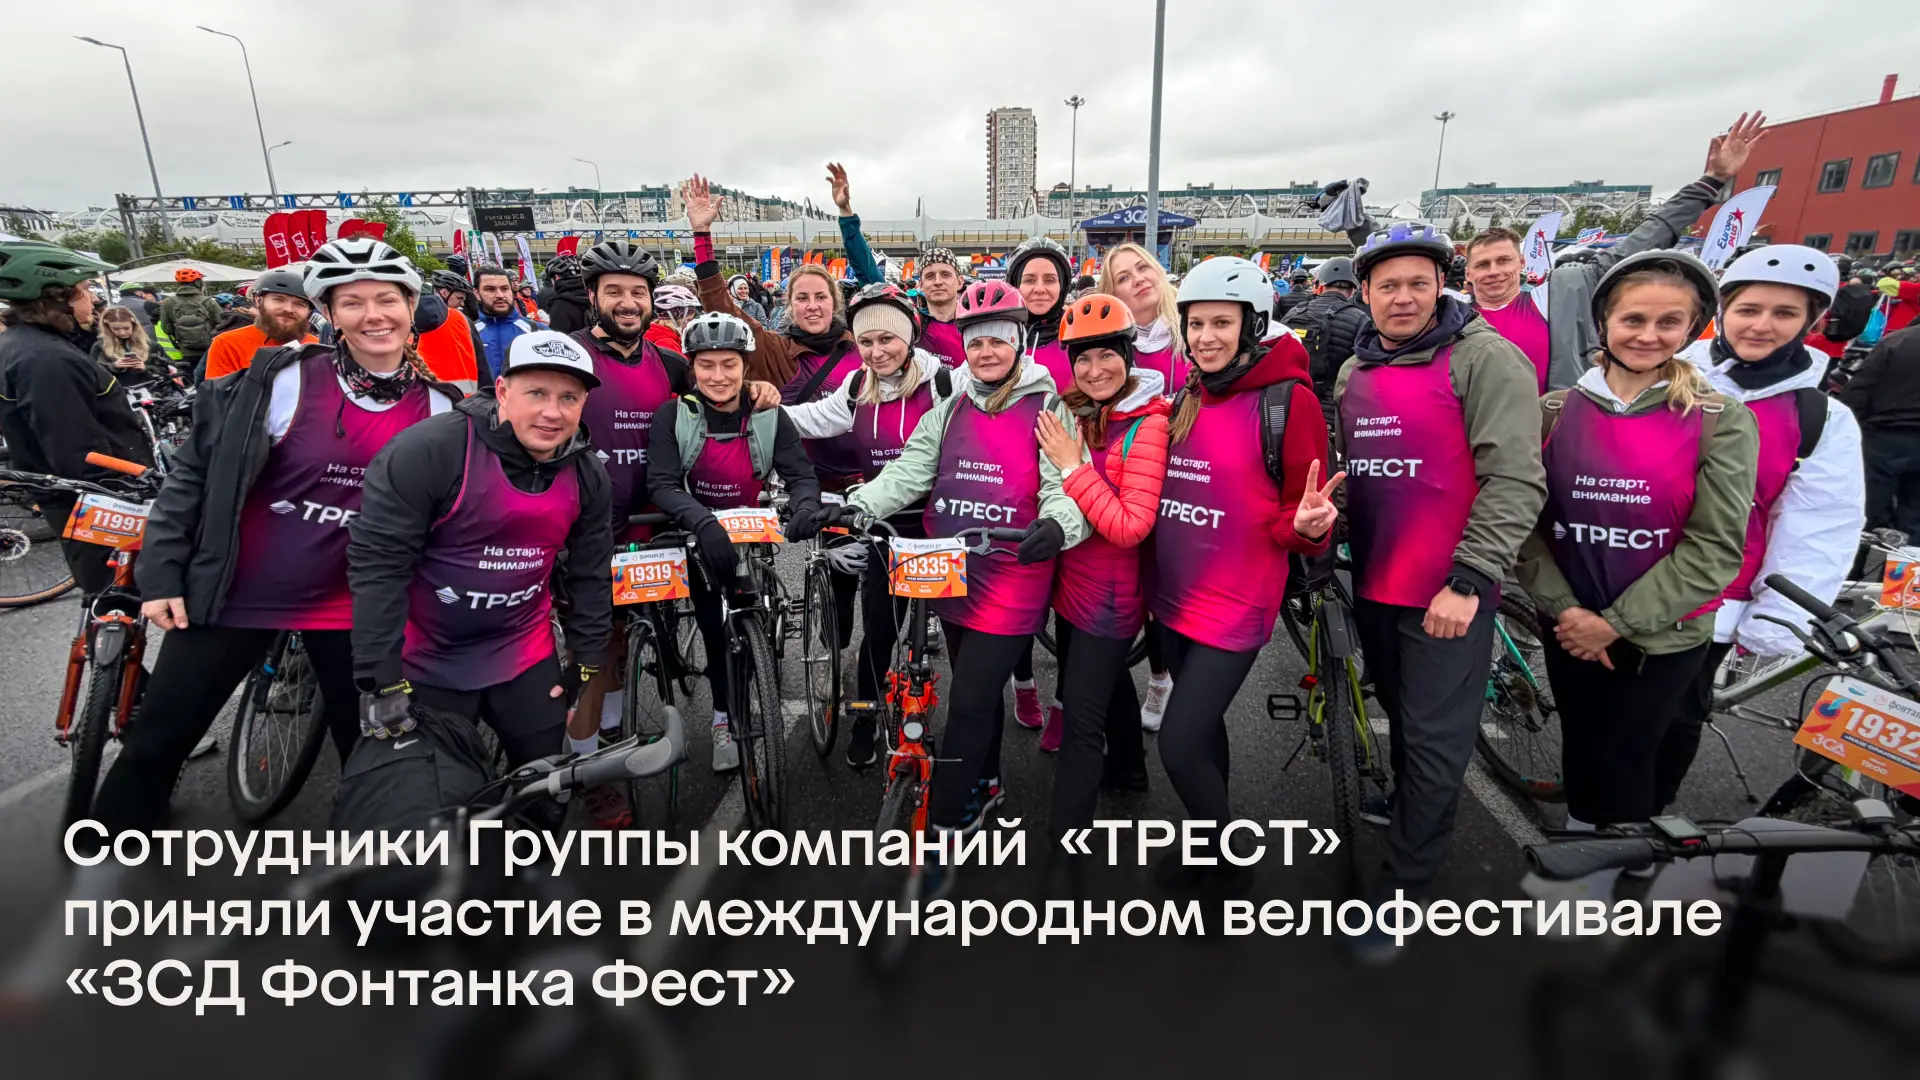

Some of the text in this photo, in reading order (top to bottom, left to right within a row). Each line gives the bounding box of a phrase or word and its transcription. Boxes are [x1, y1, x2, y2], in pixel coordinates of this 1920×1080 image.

[614, 409, 628, 419] На
[1356, 415, 1401, 427] На старт,
[1353, 427, 1403, 438] внимание
[612, 448, 648, 465] ТРЕ
[870, 448, 884, 457] На
[326, 462, 348, 474] На
[958, 459, 1004, 474] На старт,
[1170, 454, 1211, 471] На старт,
[1350, 458, 1423, 478] ТРЕСТ
[955, 472, 1004, 485] внимание
[1167, 469, 1211, 484] внимание
[1575, 474, 1650, 491] На старт,
[697, 480, 710, 489] На
[1572, 490, 1652, 505] внимание
[302, 500, 361, 528] ТРЕ
[948, 498, 1017, 524] ТРЕСТ
[1160, 498, 1225, 529] ТРЕСТ
[93, 509, 145, 533] 11991
[723, 517, 765, 529] 19315
[1568, 522, 1671, 550] ТРЕСТ
[483, 545, 545, 558] На старт,
[478, 558, 544, 571] внимание
[901, 554, 950, 575] 19335
[627, 563, 672, 583] 19319
